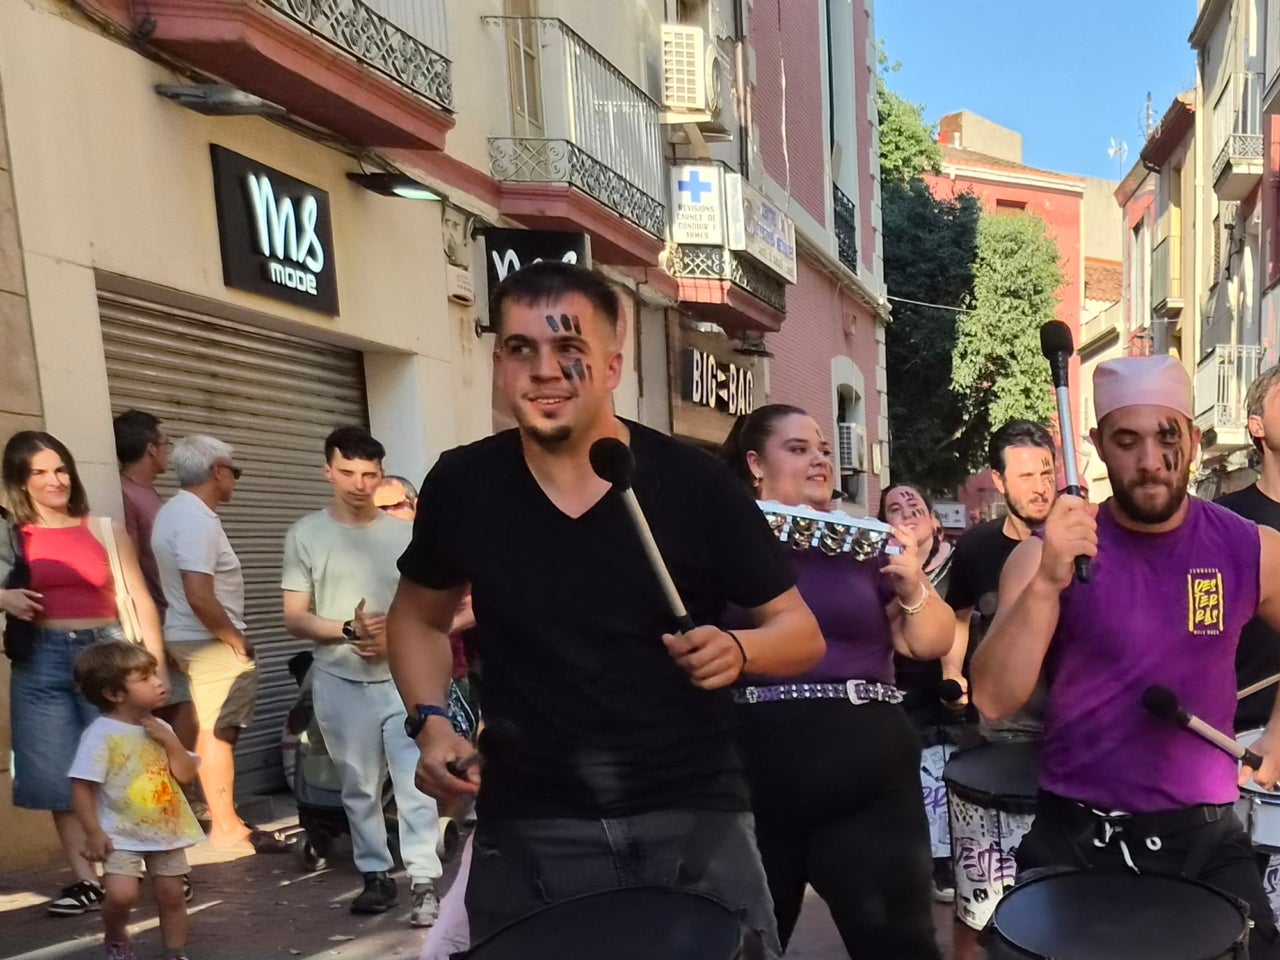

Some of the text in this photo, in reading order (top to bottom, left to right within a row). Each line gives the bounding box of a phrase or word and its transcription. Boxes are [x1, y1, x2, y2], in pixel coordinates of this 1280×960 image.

[678, 204, 716, 213] REVISIONS
[676, 213, 704, 221] CARNET
[678, 222, 710, 231] CONDUIR
[685, 232, 711, 240] ARMES
[692, 348, 754, 416] BIG BAG
